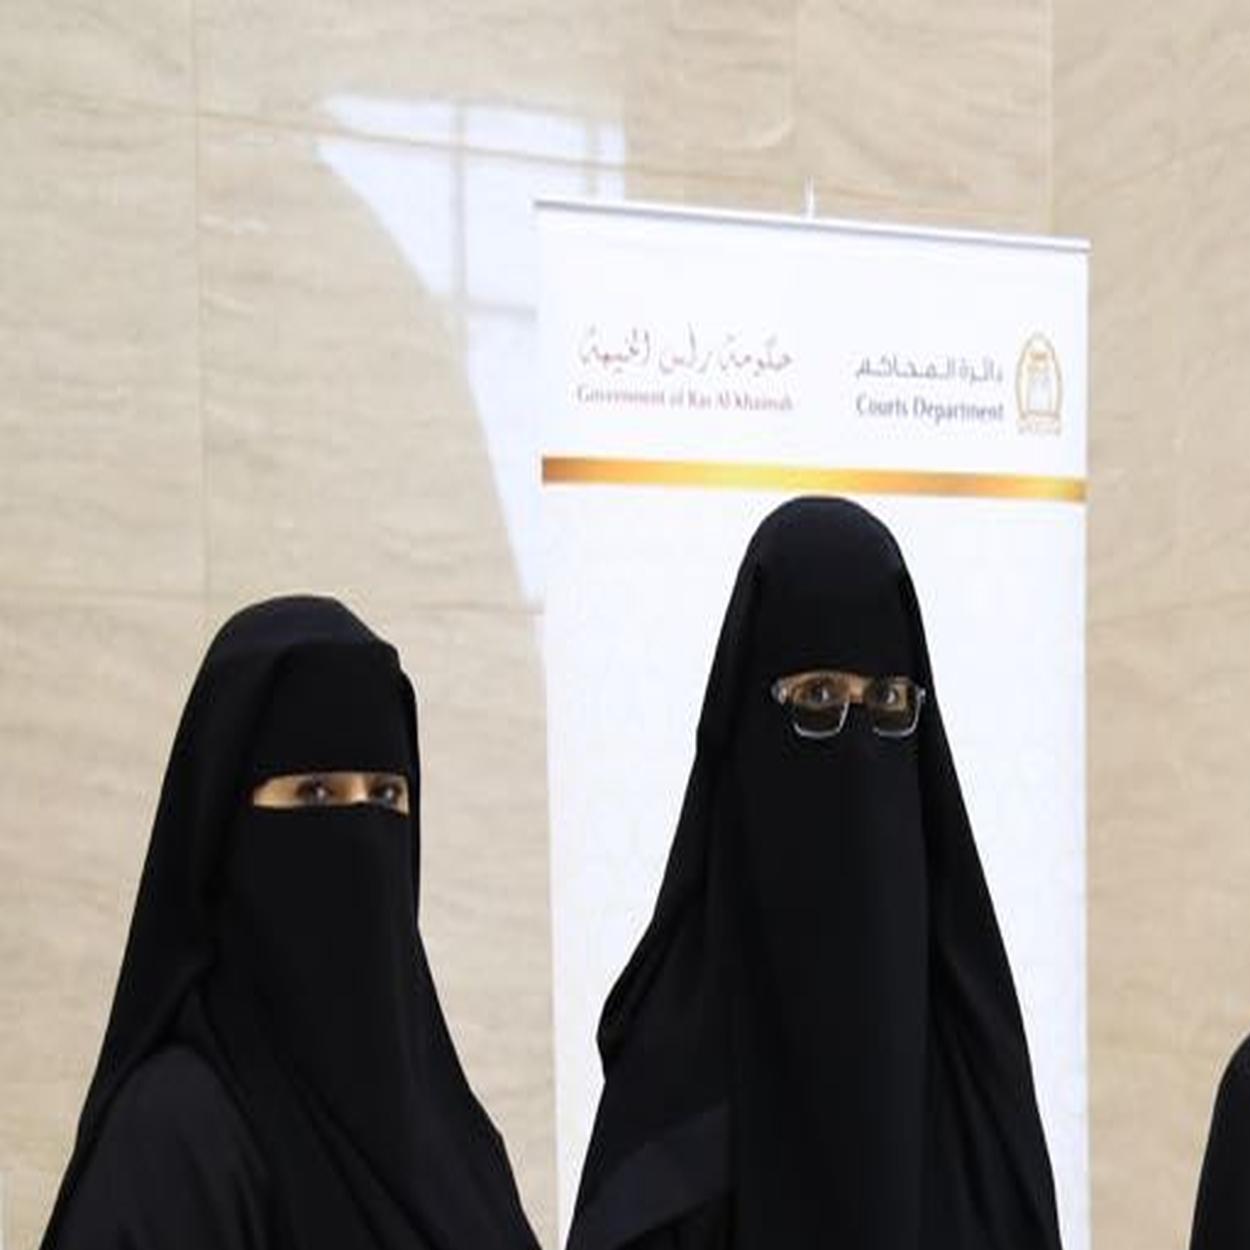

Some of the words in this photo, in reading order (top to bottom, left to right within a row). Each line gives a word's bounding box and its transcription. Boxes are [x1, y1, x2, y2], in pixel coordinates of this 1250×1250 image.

[577, 381, 665, 403] Government
[855, 392, 908, 421] Courts
[912, 395, 1004, 428] Department
